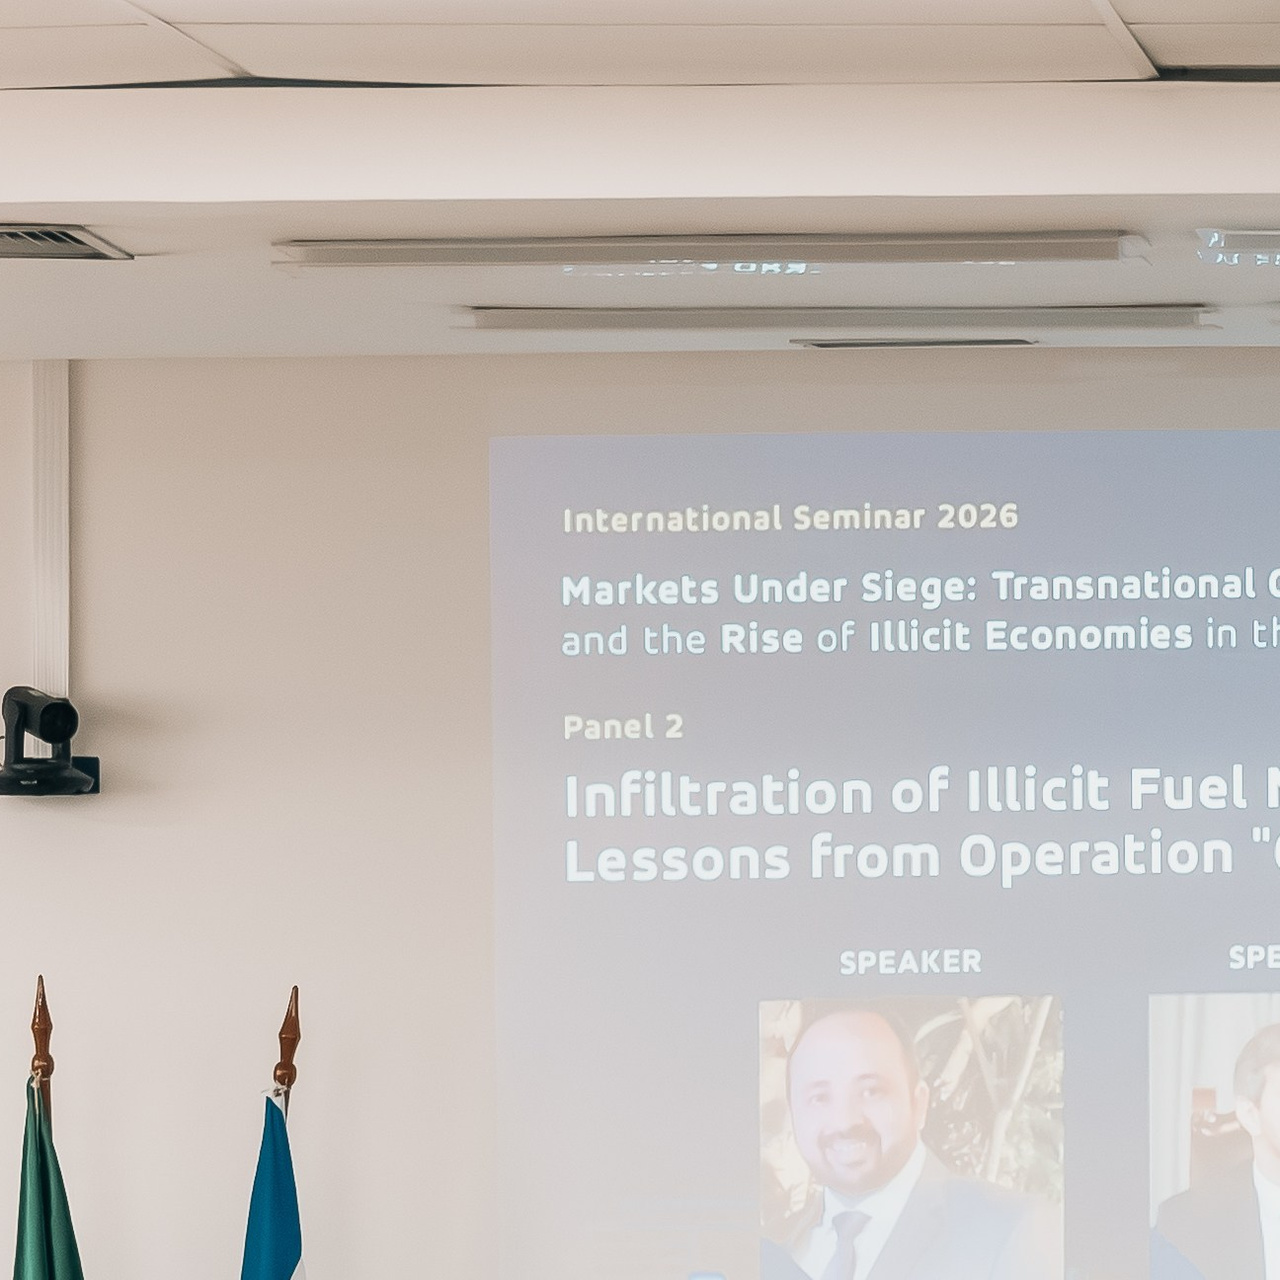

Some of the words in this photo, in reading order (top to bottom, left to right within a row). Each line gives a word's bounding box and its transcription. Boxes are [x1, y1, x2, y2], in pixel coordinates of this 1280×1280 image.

[564, 504, 782, 533] International
[793, 502, 926, 531] Seminar
[937, 502, 1018, 529] 2026
[562, 573, 719, 606] Markets
[734, 571, 848, 604] Under
[862, 569, 976, 610] Siege:
[991, 566, 1256, 600] Transnational
[562, 624, 627, 656] and
[644, 623, 706, 655] the
[721, 621, 803, 654] Rise
[817, 620, 855, 653] of
[871, 618, 971, 652] Illicit
[986, 616, 1193, 650] Economies
[1207, 616, 1237, 649] in
[564, 712, 654, 740] Panel
[665, 713, 683, 739] 2
[567, 768, 872, 818] Infiltration
[891, 765, 950, 813] of
[968, 764, 1110, 812] Illicit
[1131, 763, 1248, 810] Fuel
[566, 840, 790, 882] Lessons
[811, 832, 940, 878] from
[960, 828, 1233, 889] Operation
[840, 948, 982, 975] SPEAKER
